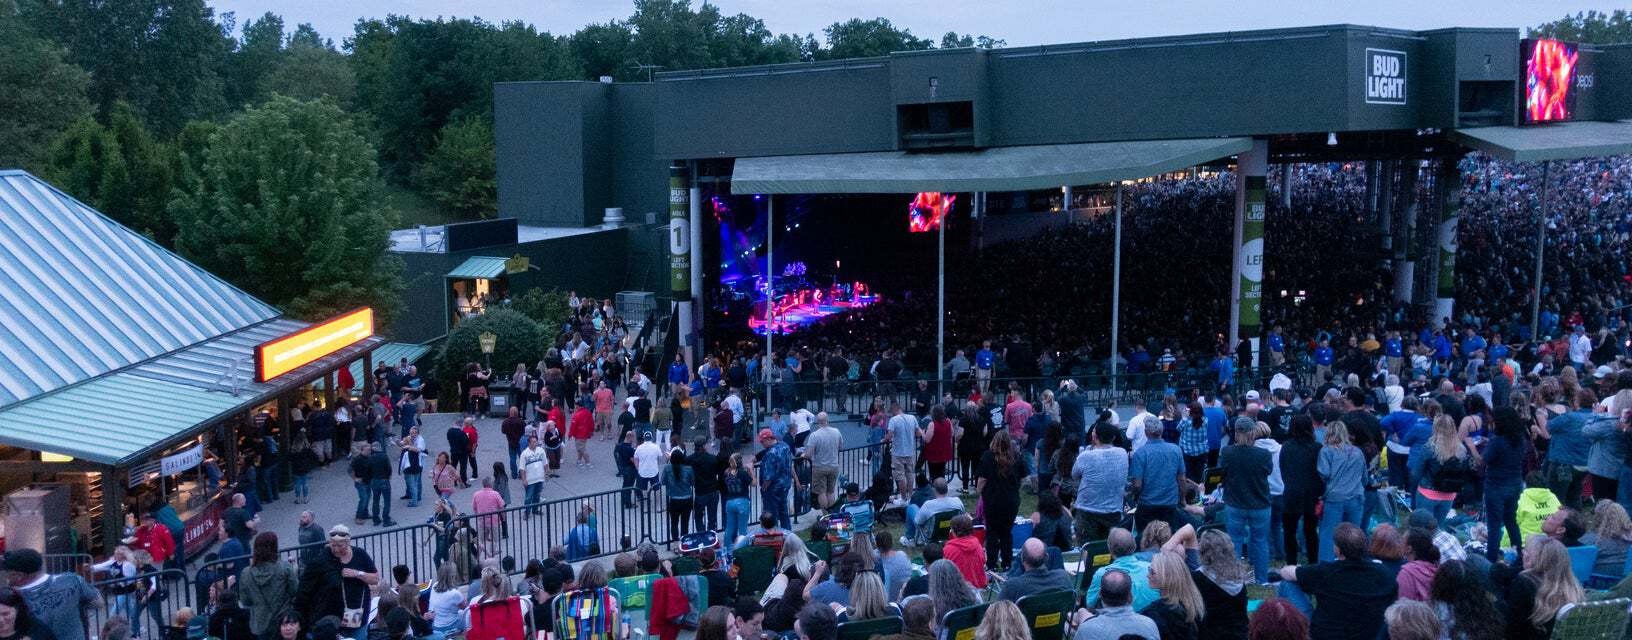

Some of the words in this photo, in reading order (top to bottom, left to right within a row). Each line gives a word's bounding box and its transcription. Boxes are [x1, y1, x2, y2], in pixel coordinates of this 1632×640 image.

[1373, 54, 1400, 77] BUD
[1368, 76, 1404, 98] LIGHT
[673, 226, 682, 247] 1
[1246, 255, 1263, 266] LEF
[185, 519, 211, 543] LINDO'S
